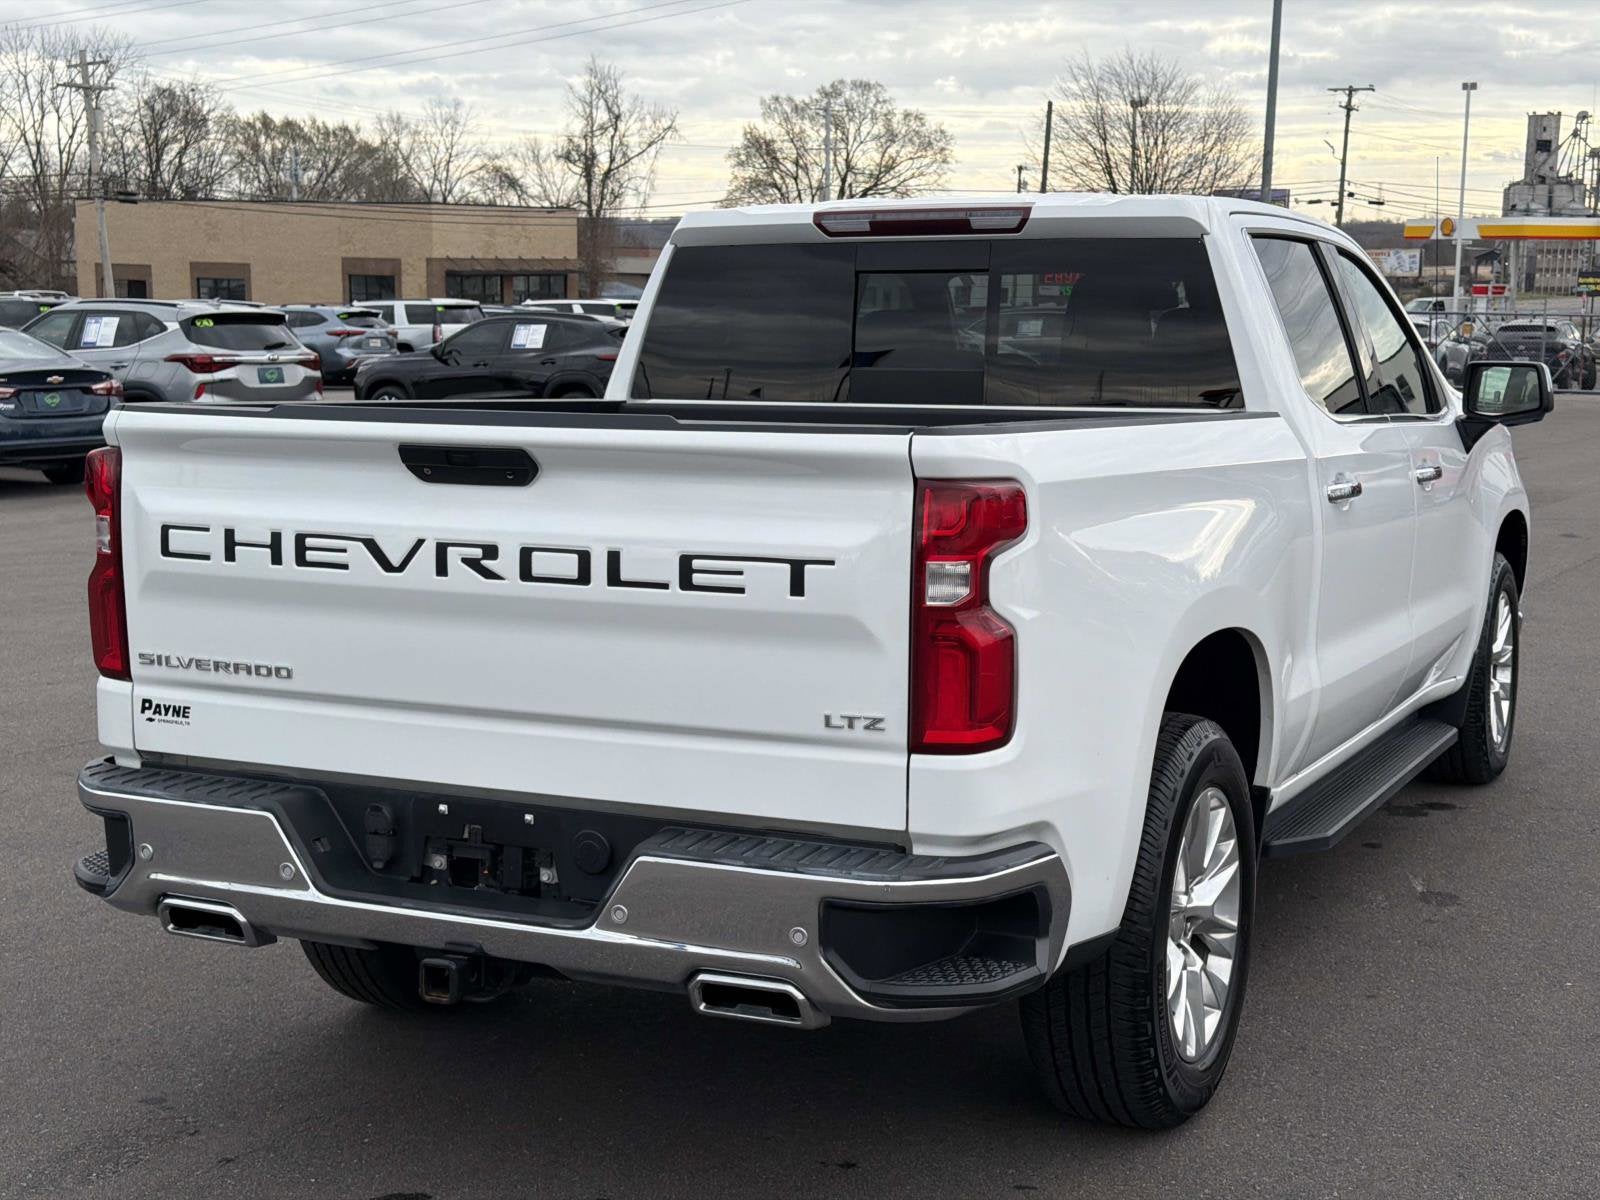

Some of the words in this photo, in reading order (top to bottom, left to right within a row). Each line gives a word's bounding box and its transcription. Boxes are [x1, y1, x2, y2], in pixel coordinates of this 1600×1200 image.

[160, 523, 836, 598] CHEVROLET
[138, 653, 293, 679] SILVERADO
[824, 713, 886, 732] LTZ
